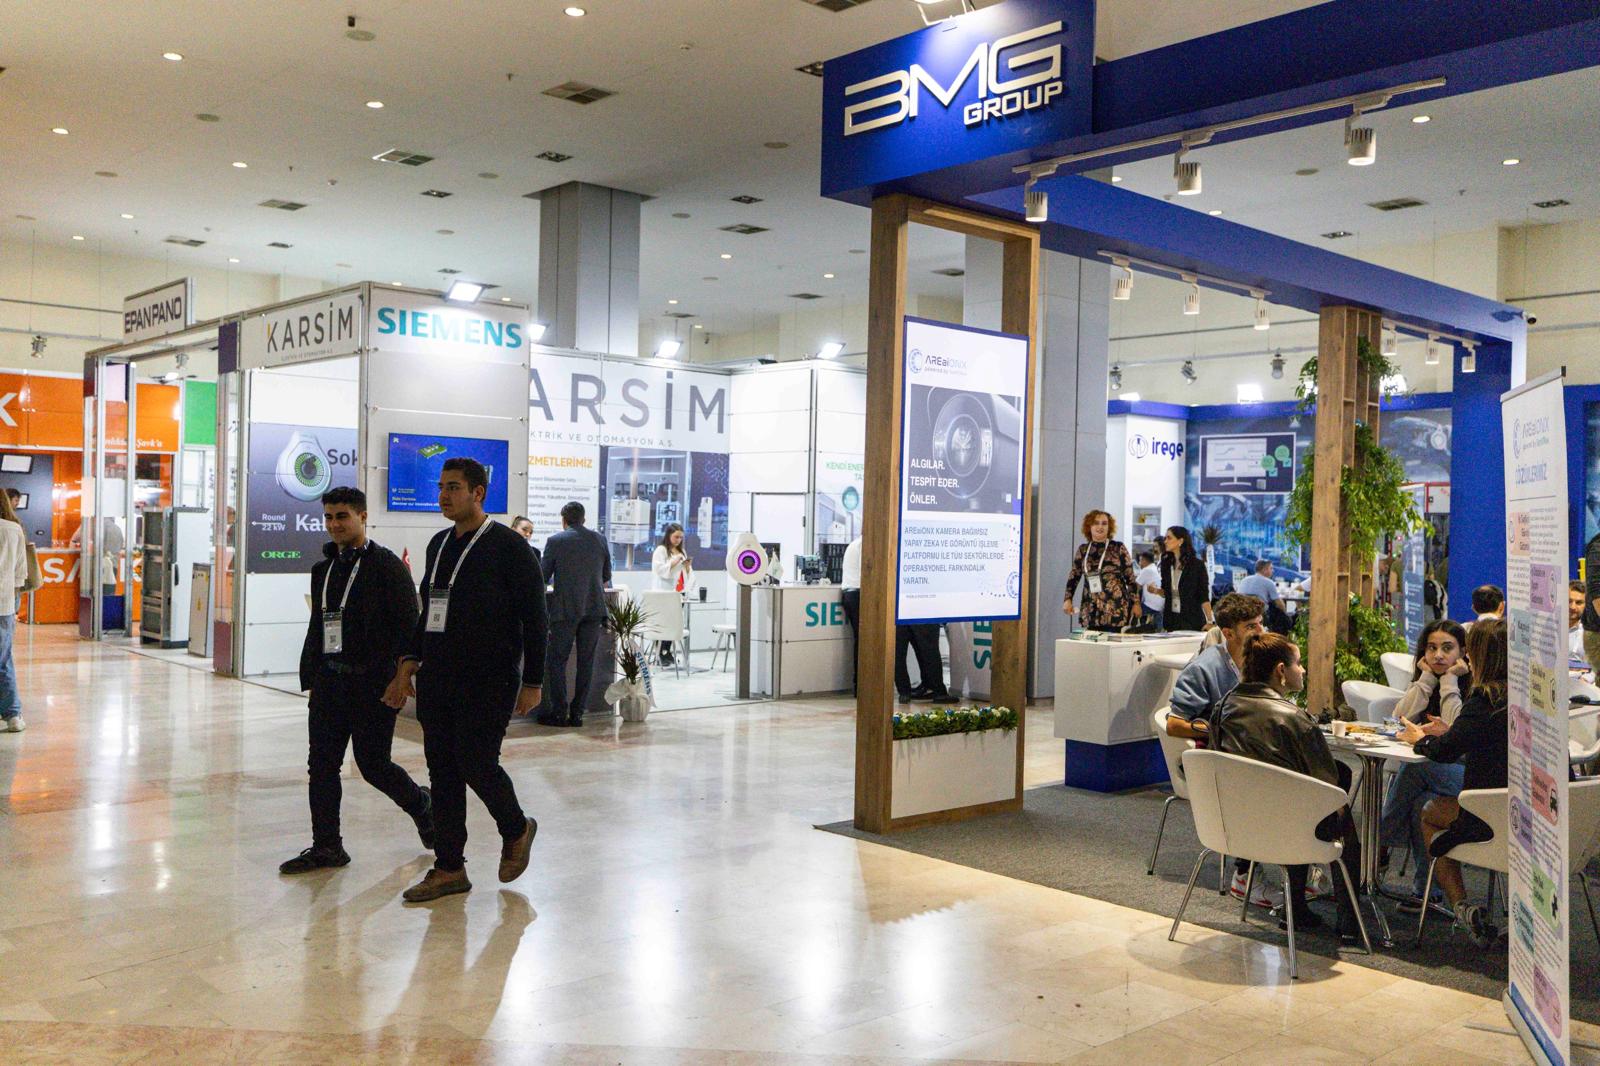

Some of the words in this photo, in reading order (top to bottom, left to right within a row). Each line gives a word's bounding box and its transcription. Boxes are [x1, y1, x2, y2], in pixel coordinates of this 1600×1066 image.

[844, 20, 1062, 136] BMG
[963, 80, 1063, 126] GROUP
[266, 302, 353, 353] KARSİM
[377, 307, 522, 349] SIEMENS
[587, 434, 653, 446] OTOMASYON
[1152, 437, 1183, 460] irege
[910, 458, 945, 470] ALGILAR.
[910, 475, 937, 487] TESPİT
[937, 478, 960, 488] EDER.
[909, 493, 938, 505] ÖNLER.
[262, 513, 286, 521] Round
[935, 527, 960, 535] KAMERA
[904, 539, 923, 548] YAPAY
[923, 540, 940, 548] ZEKA
[940, 540, 948, 548] VE
[261, 550, 301, 559] ORGE
[903, 564, 947, 572] OPERASYONEL
